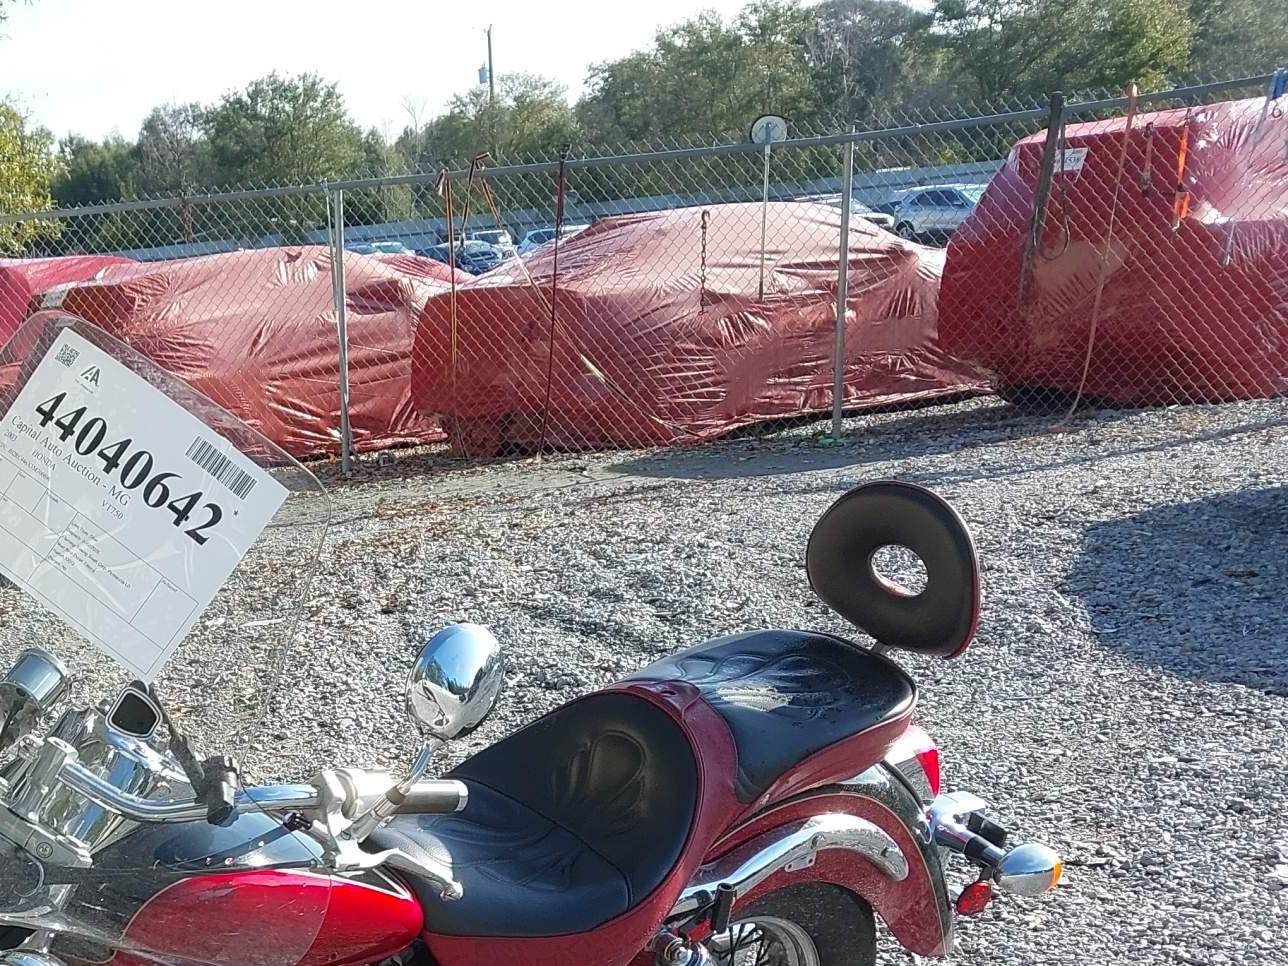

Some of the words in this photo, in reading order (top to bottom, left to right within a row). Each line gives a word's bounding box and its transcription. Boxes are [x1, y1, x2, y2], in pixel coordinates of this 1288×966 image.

[11, 415, 42, 443] Capital
[40, 436, 63, 461] Auto
[63, 454, 101, 487] Auction
[108, 484, 132, 506] MG
[32, 448, 56, 471] HONDA
[101, 499, 124, 520] VT750
[35, 391, 223, 547] 44040642
